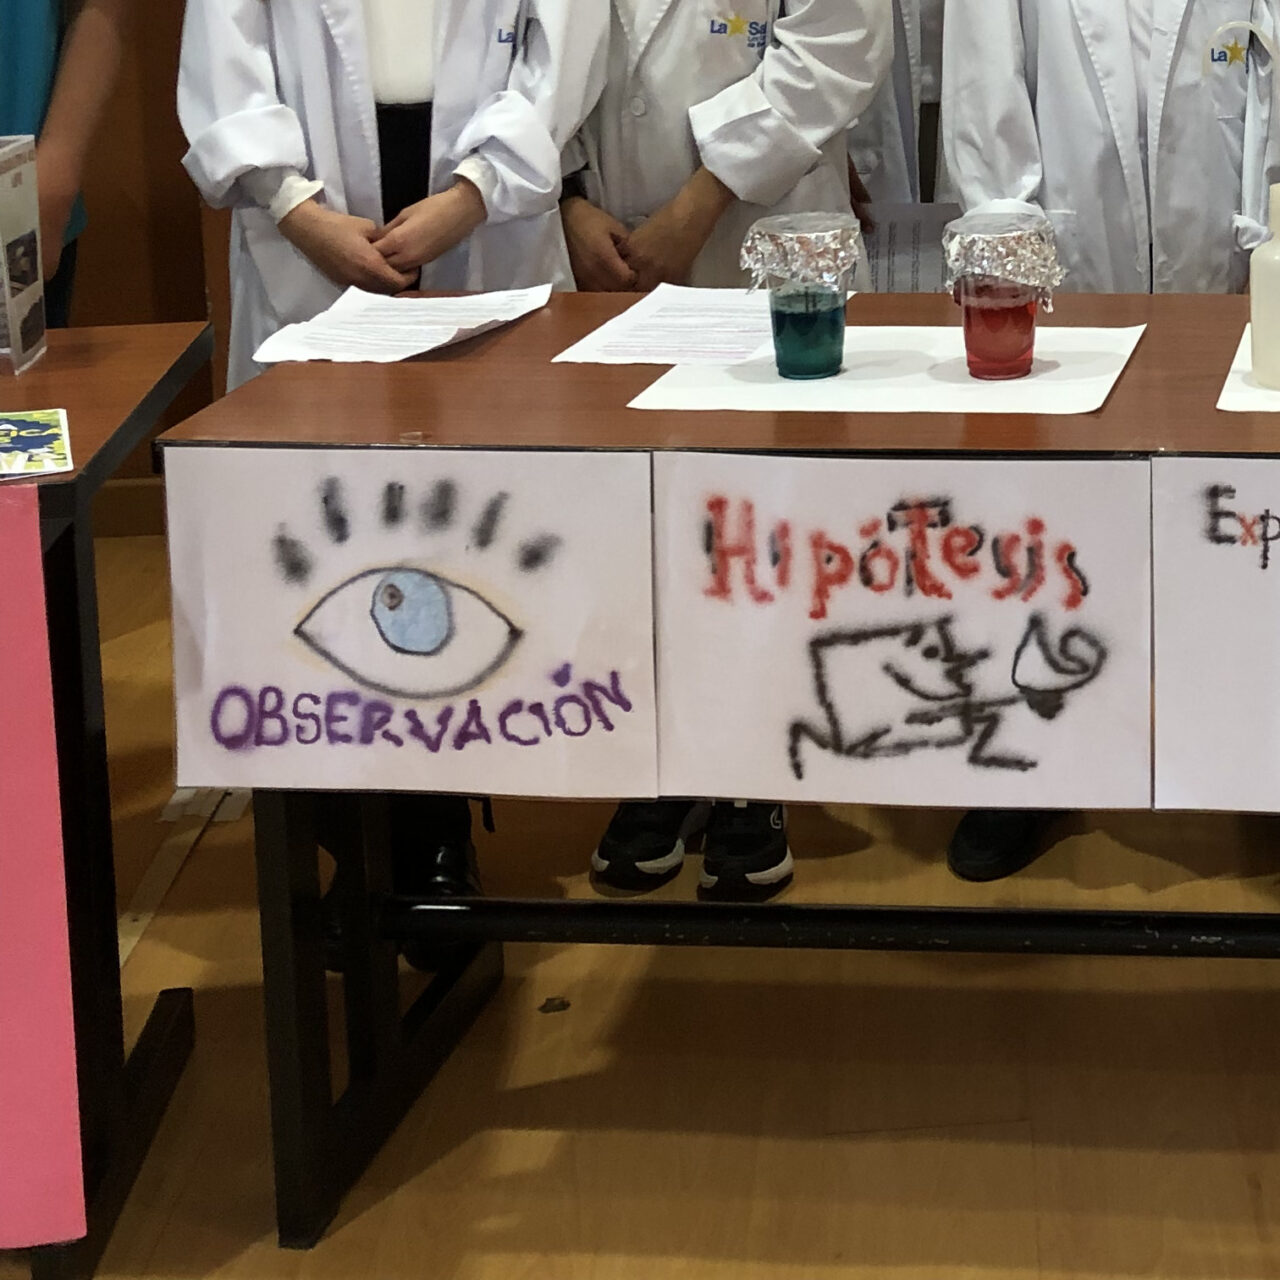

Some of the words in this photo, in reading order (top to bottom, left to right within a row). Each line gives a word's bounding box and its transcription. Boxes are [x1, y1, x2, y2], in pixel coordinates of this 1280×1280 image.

[710, 20, 728, 34] La
[1211, 48, 1228, 62] La
[211, 663, 632, 753] OBSERVACIÓN
